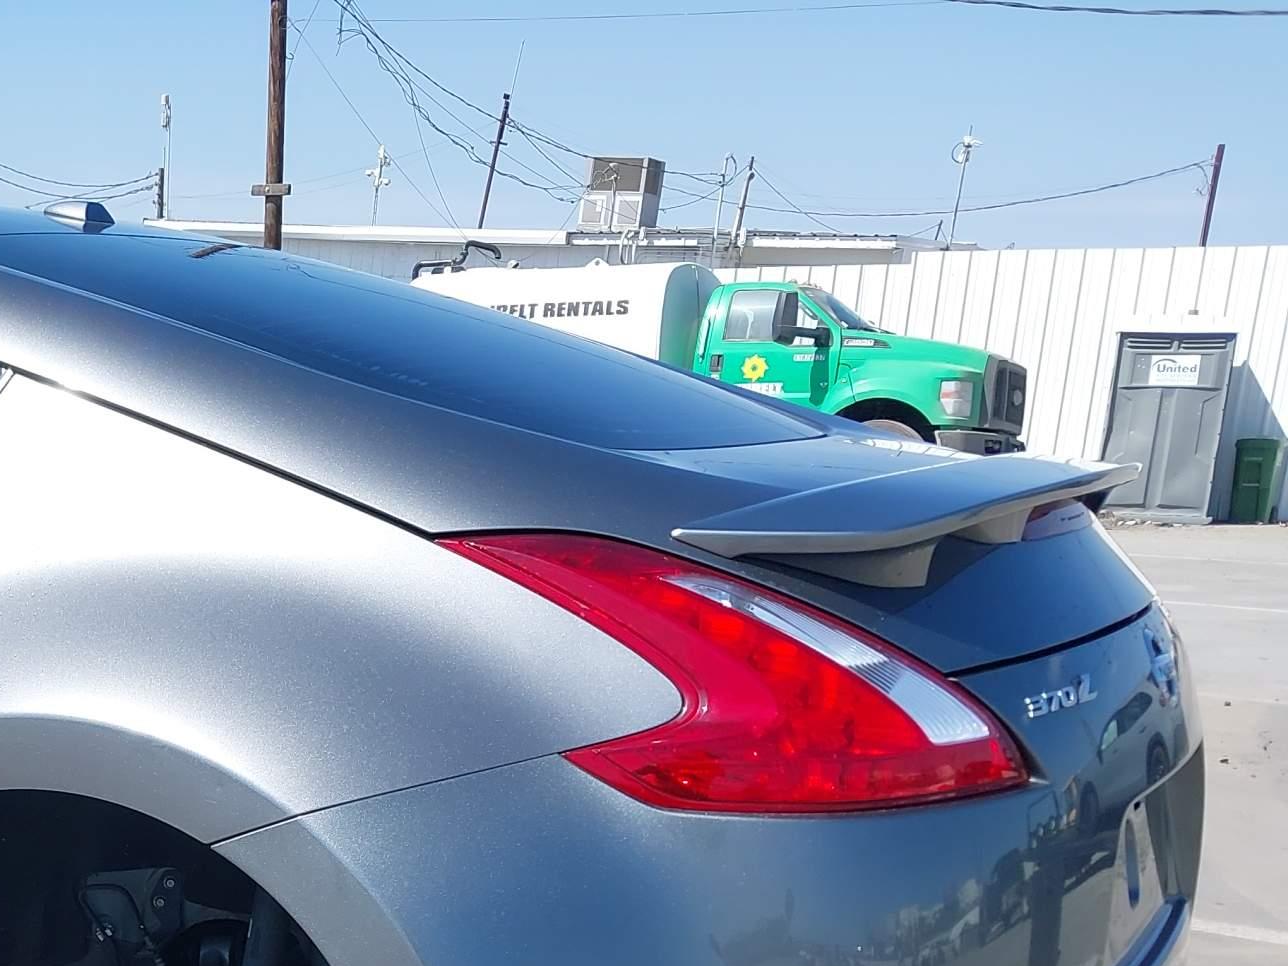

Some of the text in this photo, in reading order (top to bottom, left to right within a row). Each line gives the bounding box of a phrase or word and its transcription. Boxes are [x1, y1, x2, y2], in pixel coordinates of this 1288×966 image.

[542, 300, 630, 318] RENTALS
[1156, 363, 1198, 373] United
[1024, 673, 1098, 719] 370Z
